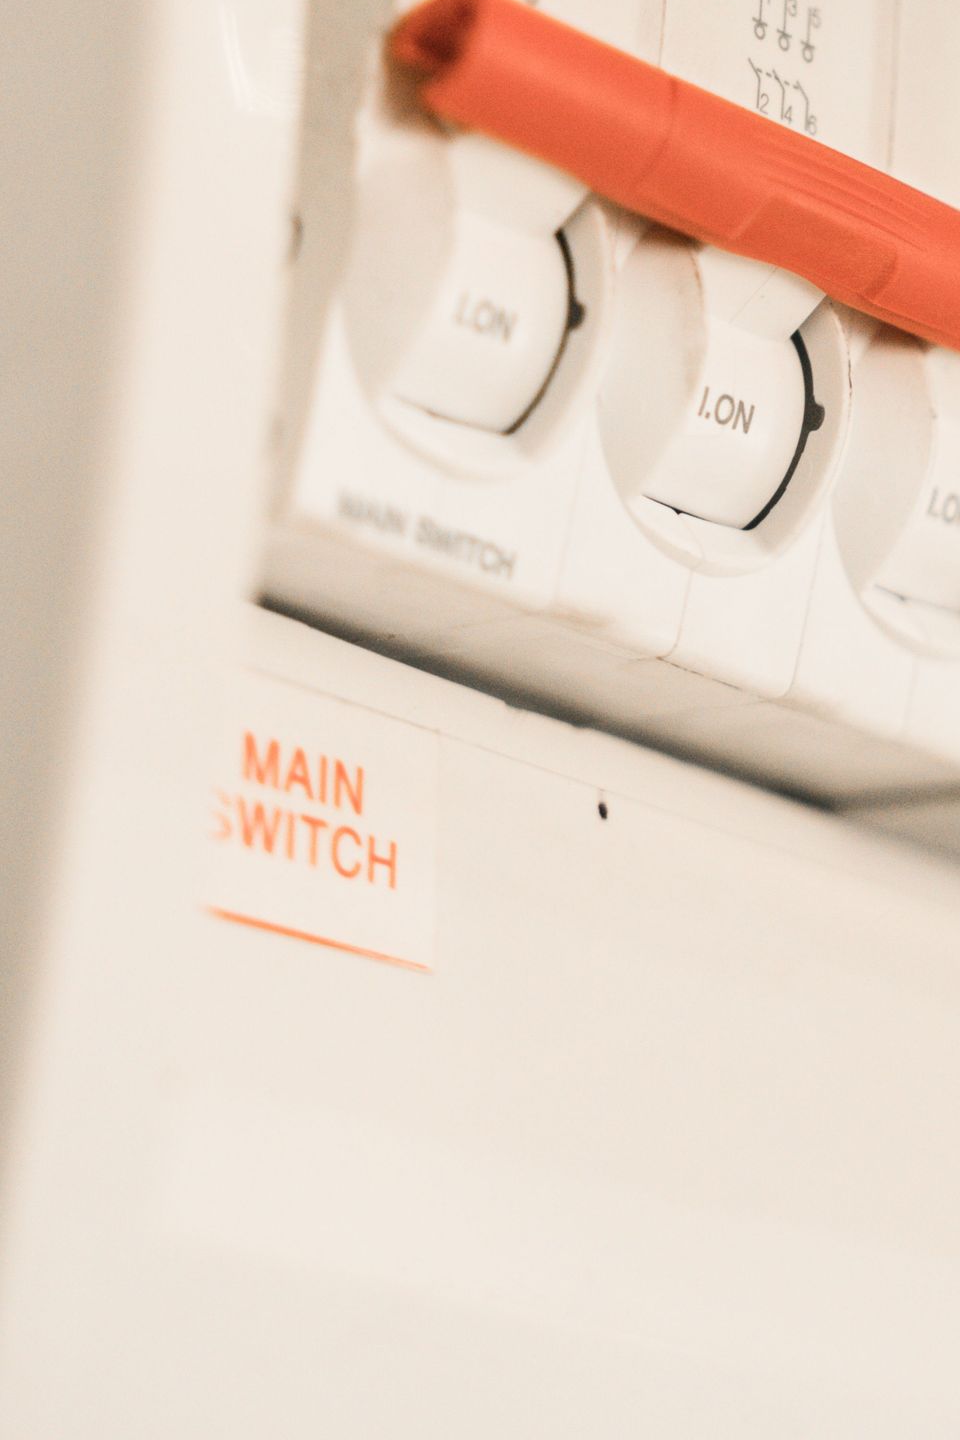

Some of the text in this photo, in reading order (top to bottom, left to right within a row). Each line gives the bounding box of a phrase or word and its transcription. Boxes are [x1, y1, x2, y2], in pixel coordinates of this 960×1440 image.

[760, 93, 770, 115] 2
[415, 516, 520, 580] SWITCH
[241, 728, 365, 817] MAIN
